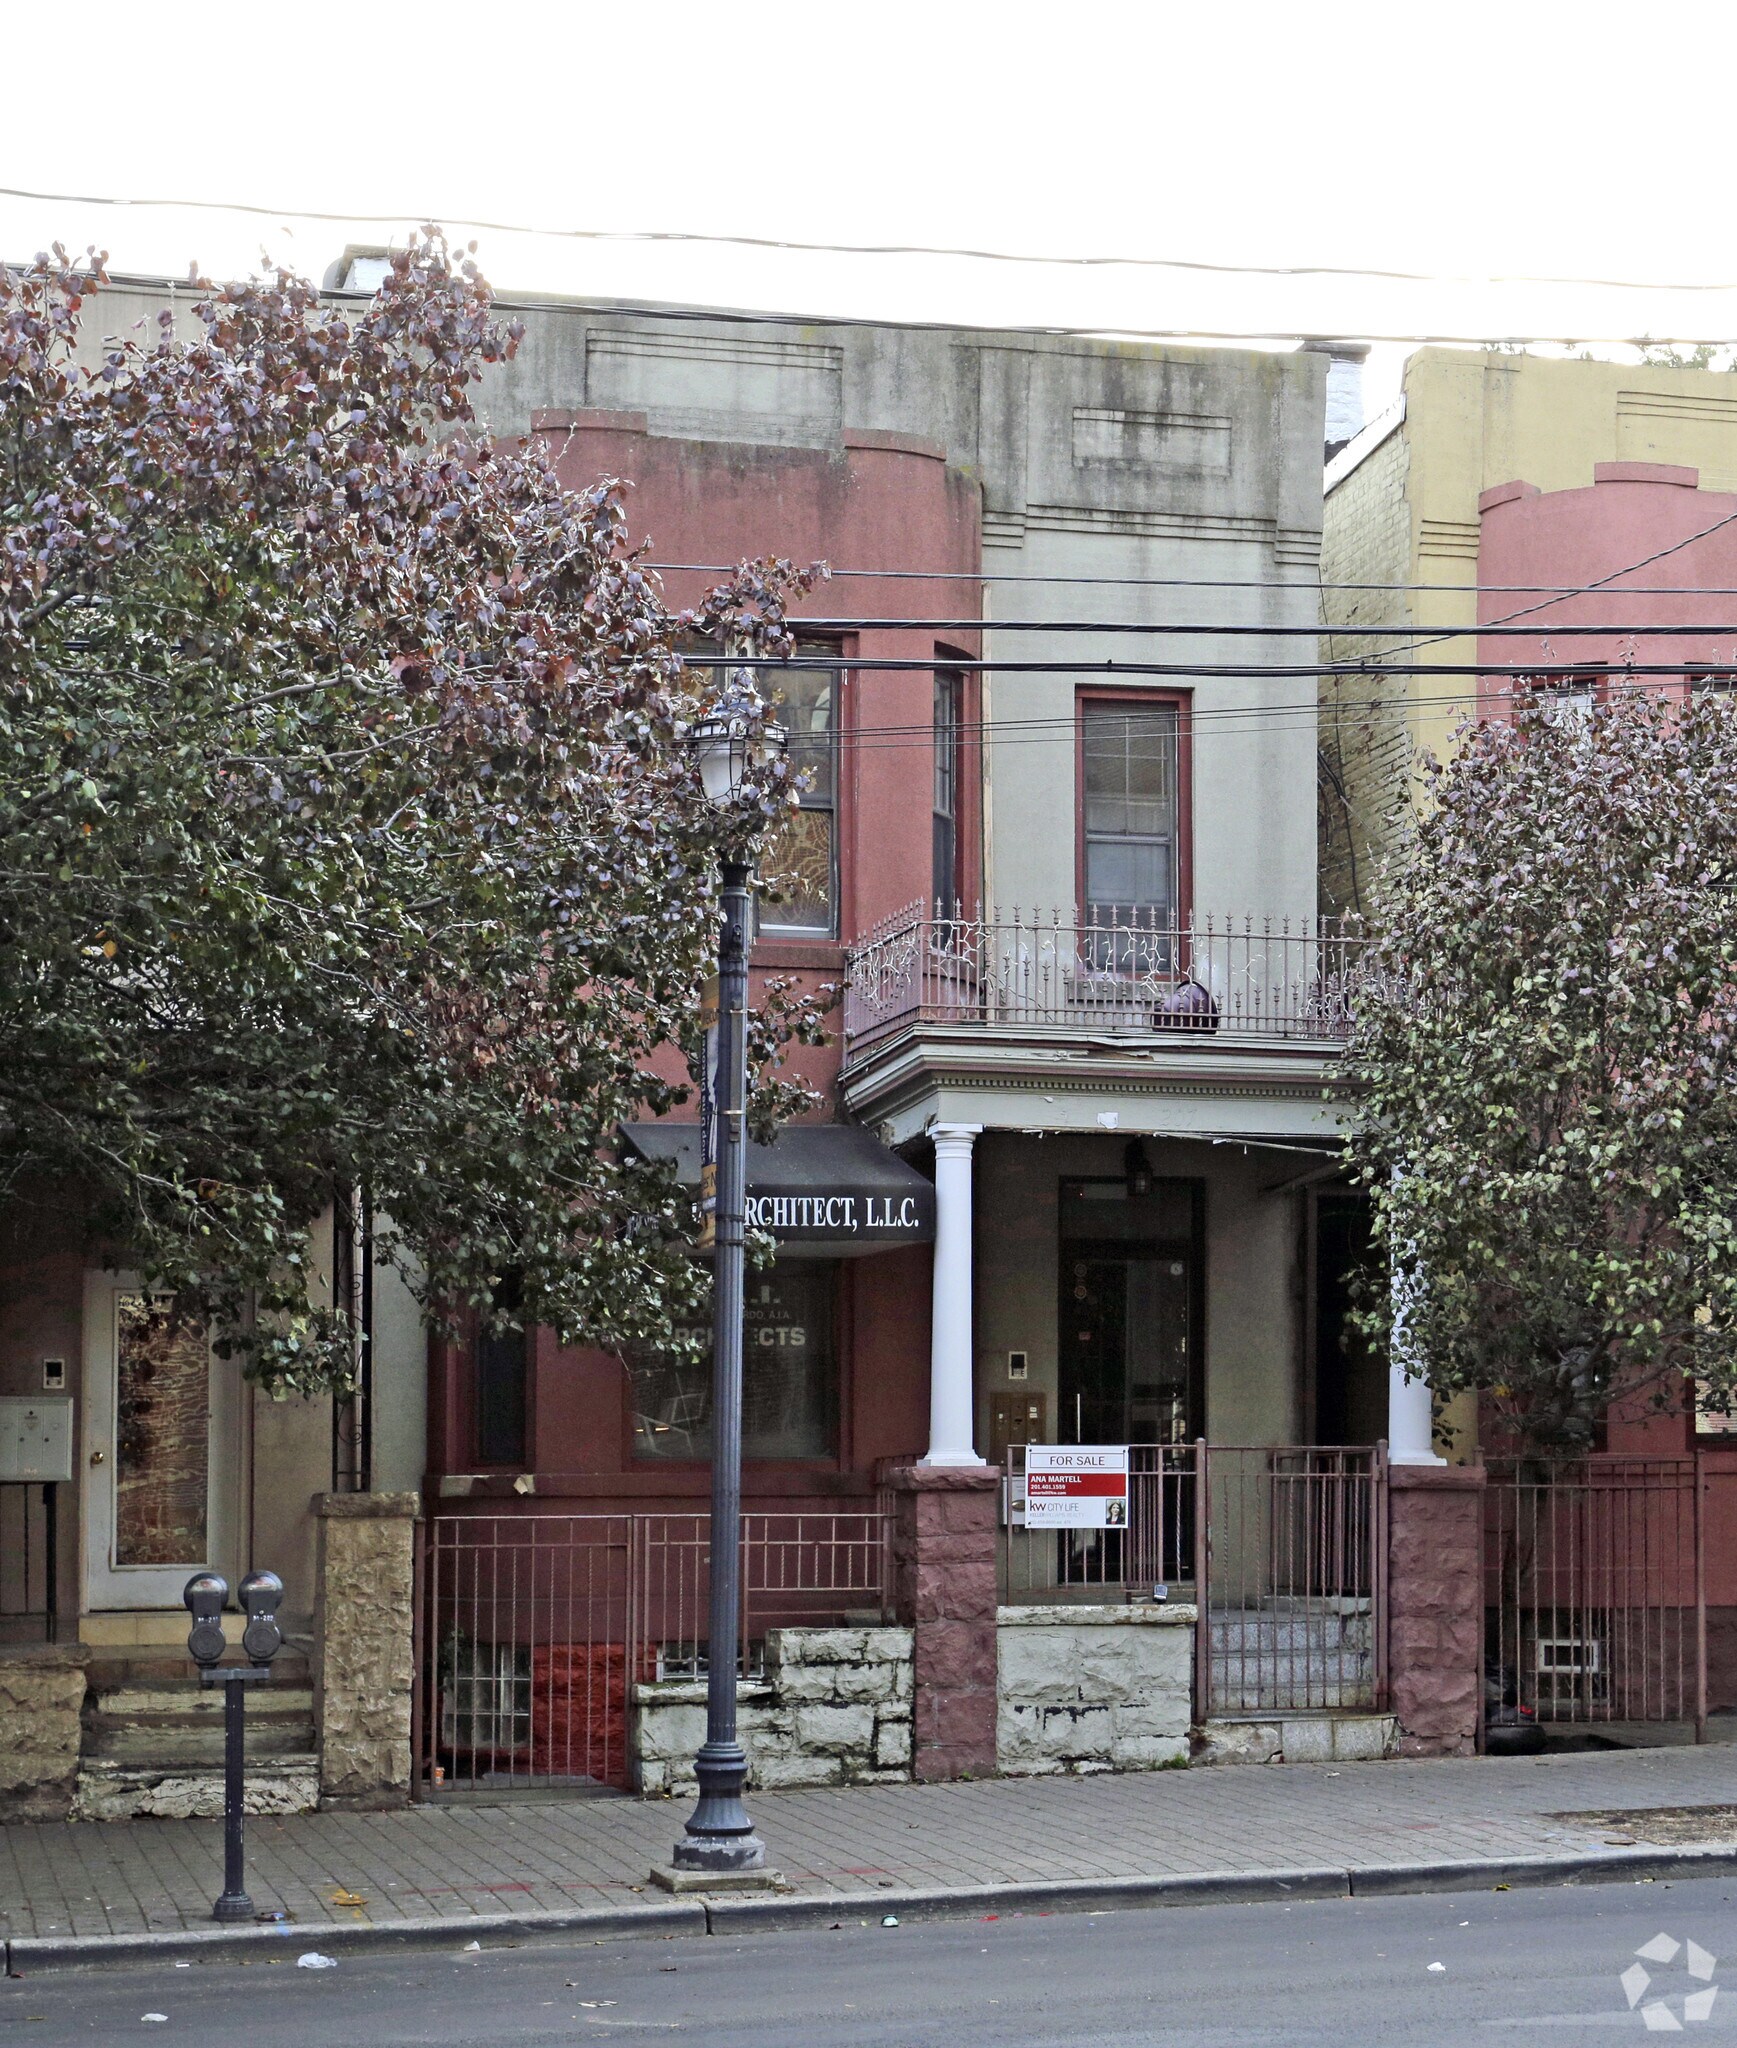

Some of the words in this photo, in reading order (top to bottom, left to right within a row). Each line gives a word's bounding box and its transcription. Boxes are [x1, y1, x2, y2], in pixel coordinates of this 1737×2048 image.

[744, 1196, 858, 1232] RCHITECT,
[865, 1197, 919, 1227] L.L.C.
[1049, 1456, 1073, 1466] FOR
[1076, 1456, 1105, 1466] SALE
[1030, 1475, 1047, 1483] ANA
[1048, 1475, 1082, 1483] MARTELL
[1029, 1499, 1047, 1511] kw
[1047, 1502, 1064, 1511] CITY
[1064, 1502, 1079, 1511] LIFE
